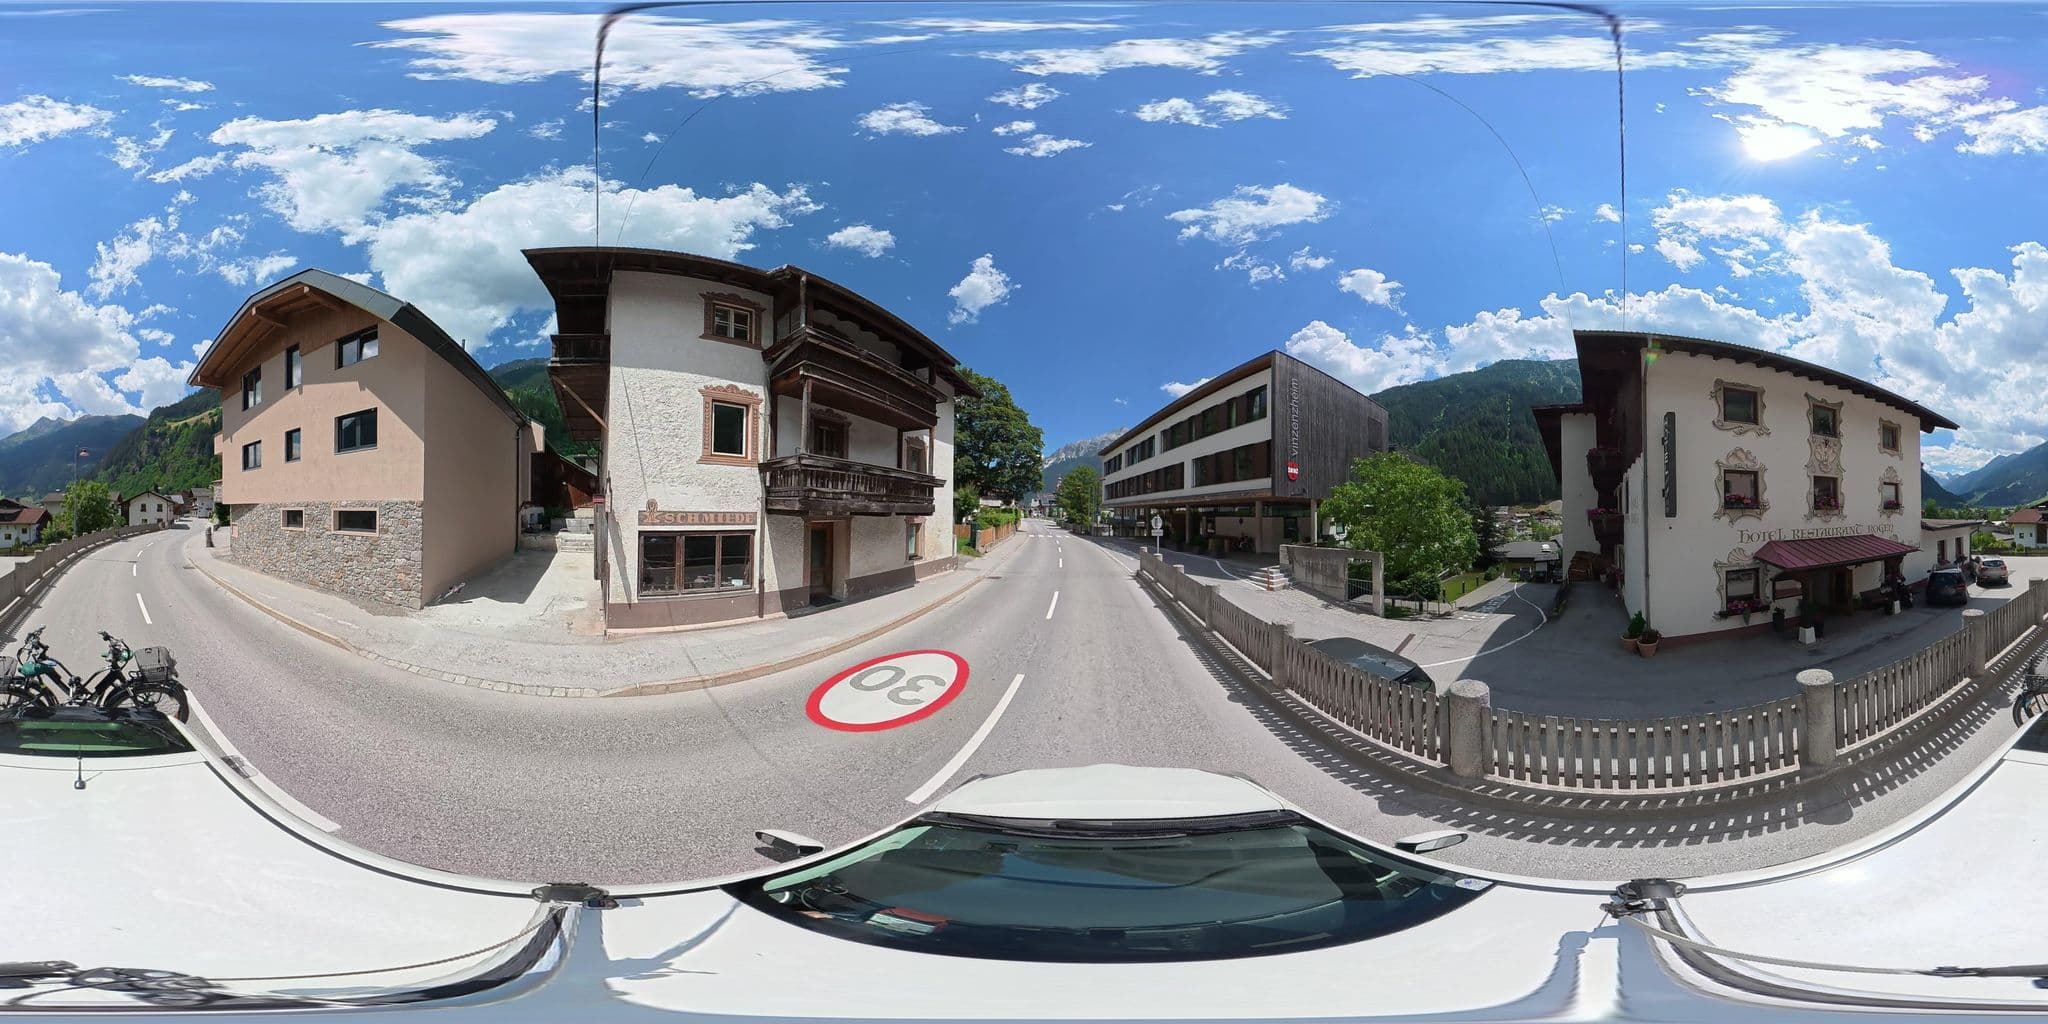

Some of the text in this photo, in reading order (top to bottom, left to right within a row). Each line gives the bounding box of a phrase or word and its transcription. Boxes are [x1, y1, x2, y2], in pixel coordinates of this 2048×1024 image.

[1289, 378, 1300, 456] vinzenzheim
[664, 513, 754, 524] SCHMIEDE
[1791, 523, 1863, 539] RESTAURANT
[850, 665, 947, 706] 30
